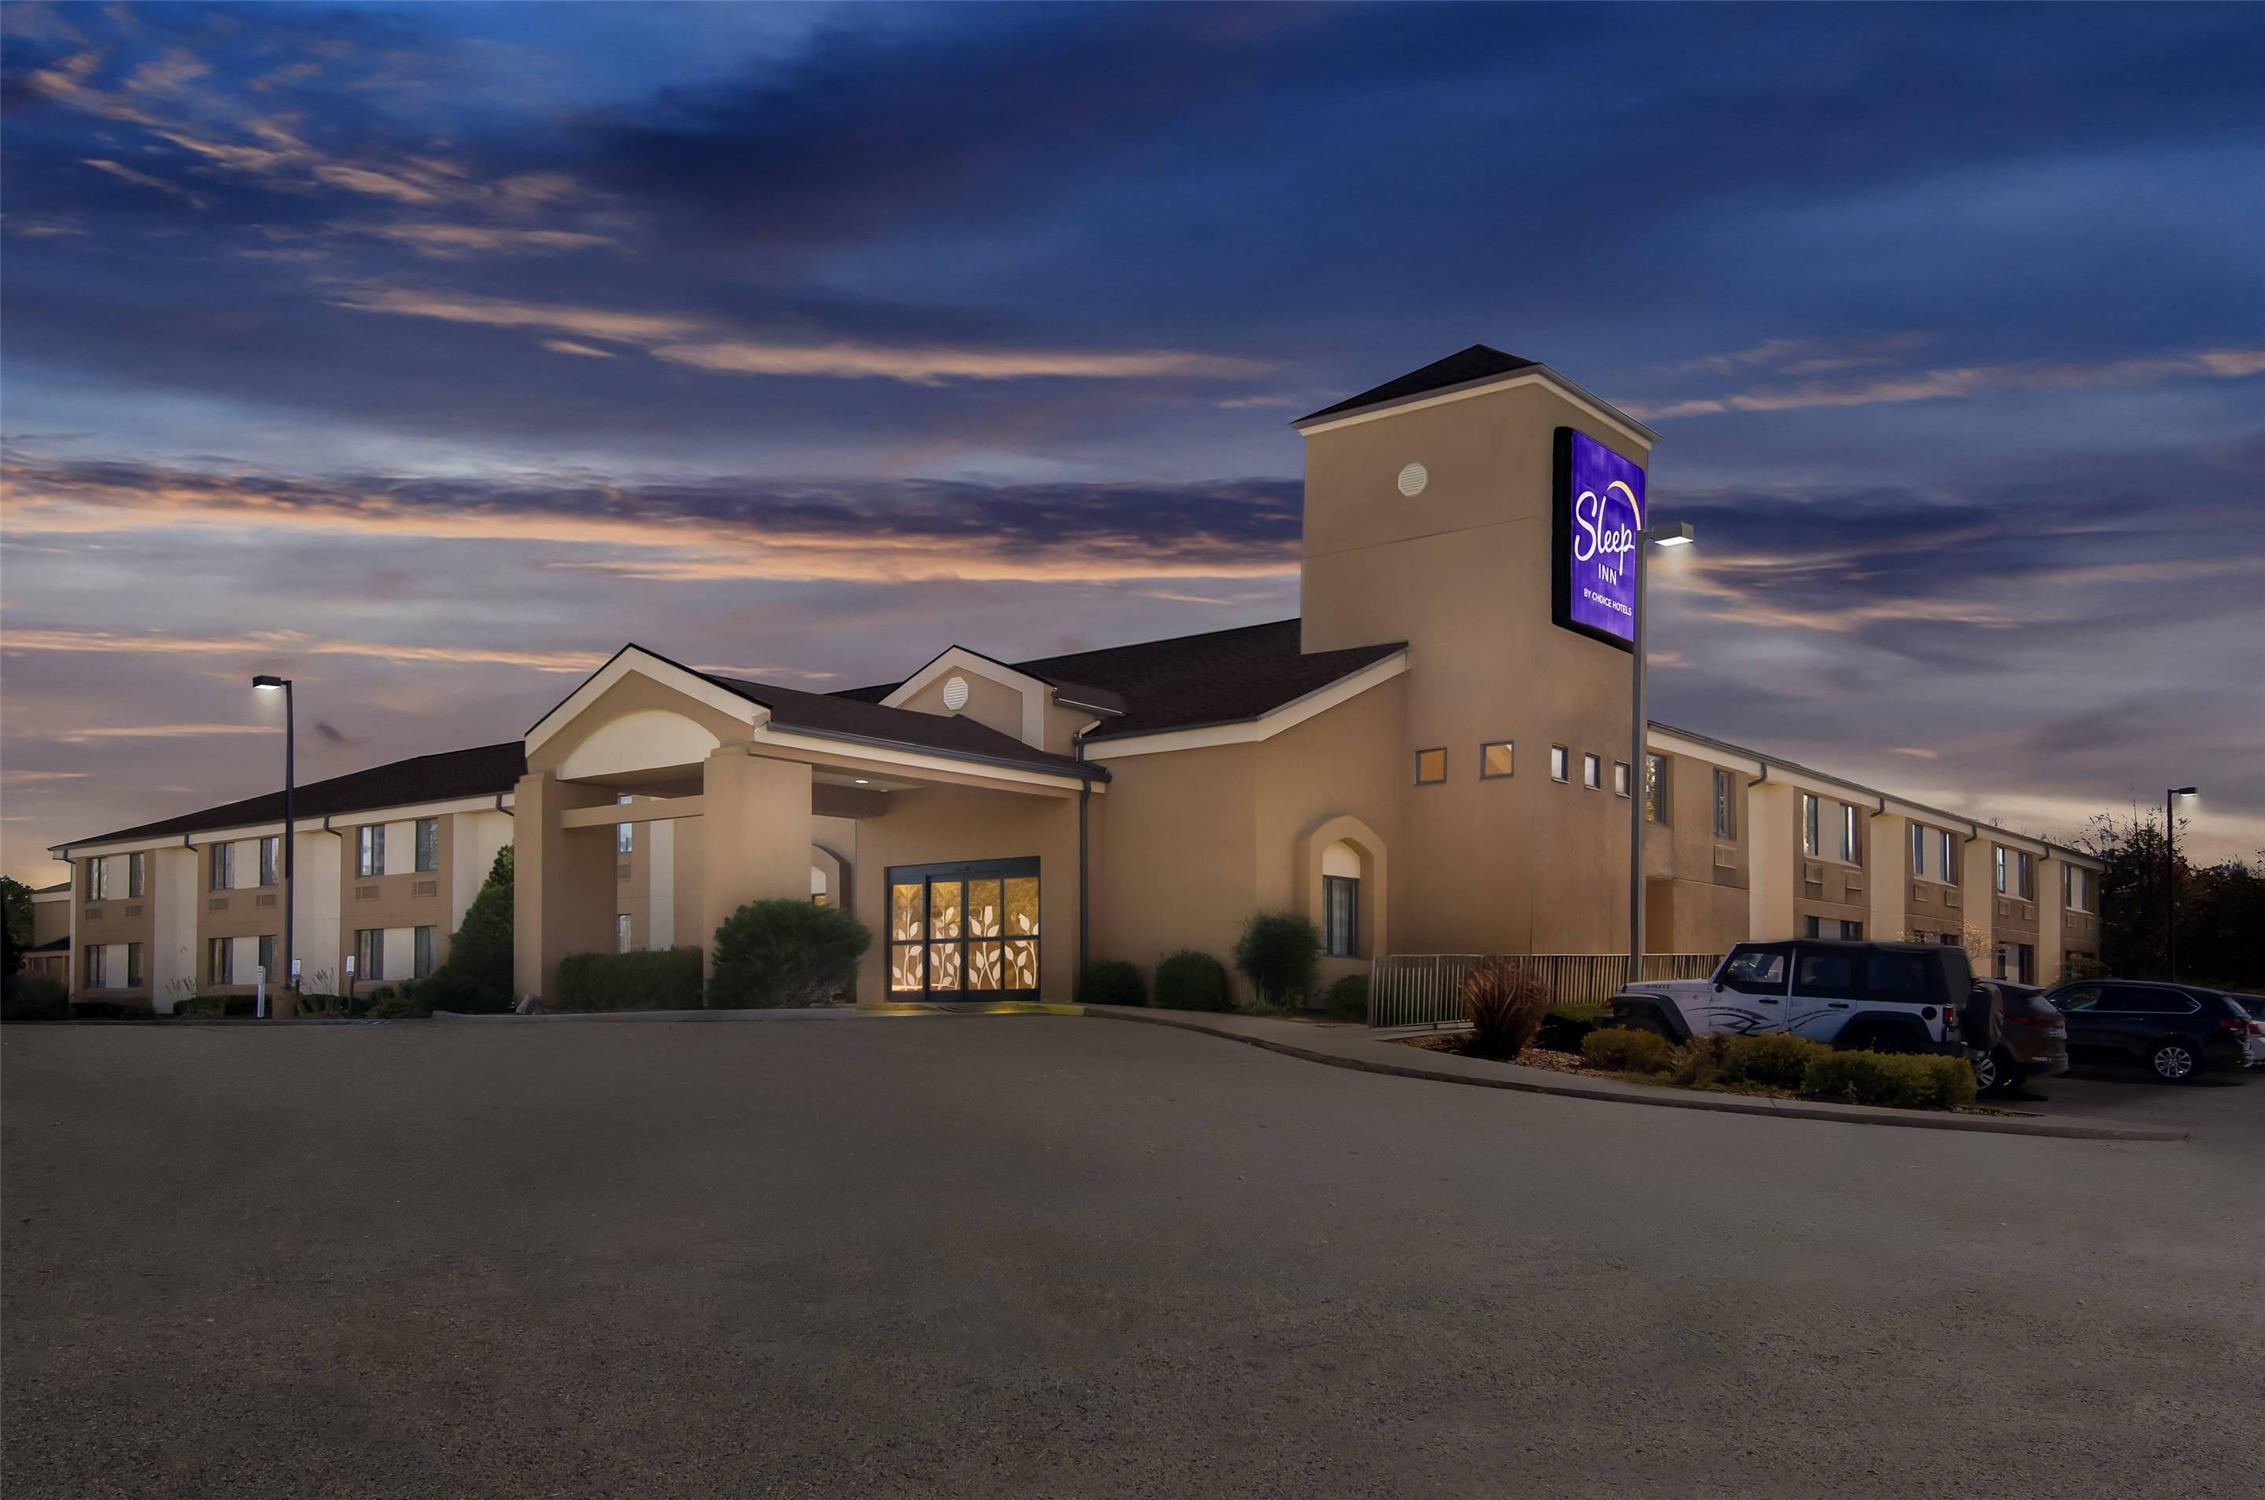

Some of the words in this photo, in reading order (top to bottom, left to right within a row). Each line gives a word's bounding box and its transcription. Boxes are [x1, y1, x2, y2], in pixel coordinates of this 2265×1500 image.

[1574, 491, 1635, 576] Sleep
[1598, 563, 1617, 585] INN
[1583, 588, 1593, 599] BY
[1592, 592, 1612, 608] CHOICE
[1612, 600, 1632, 616] HOTELS
